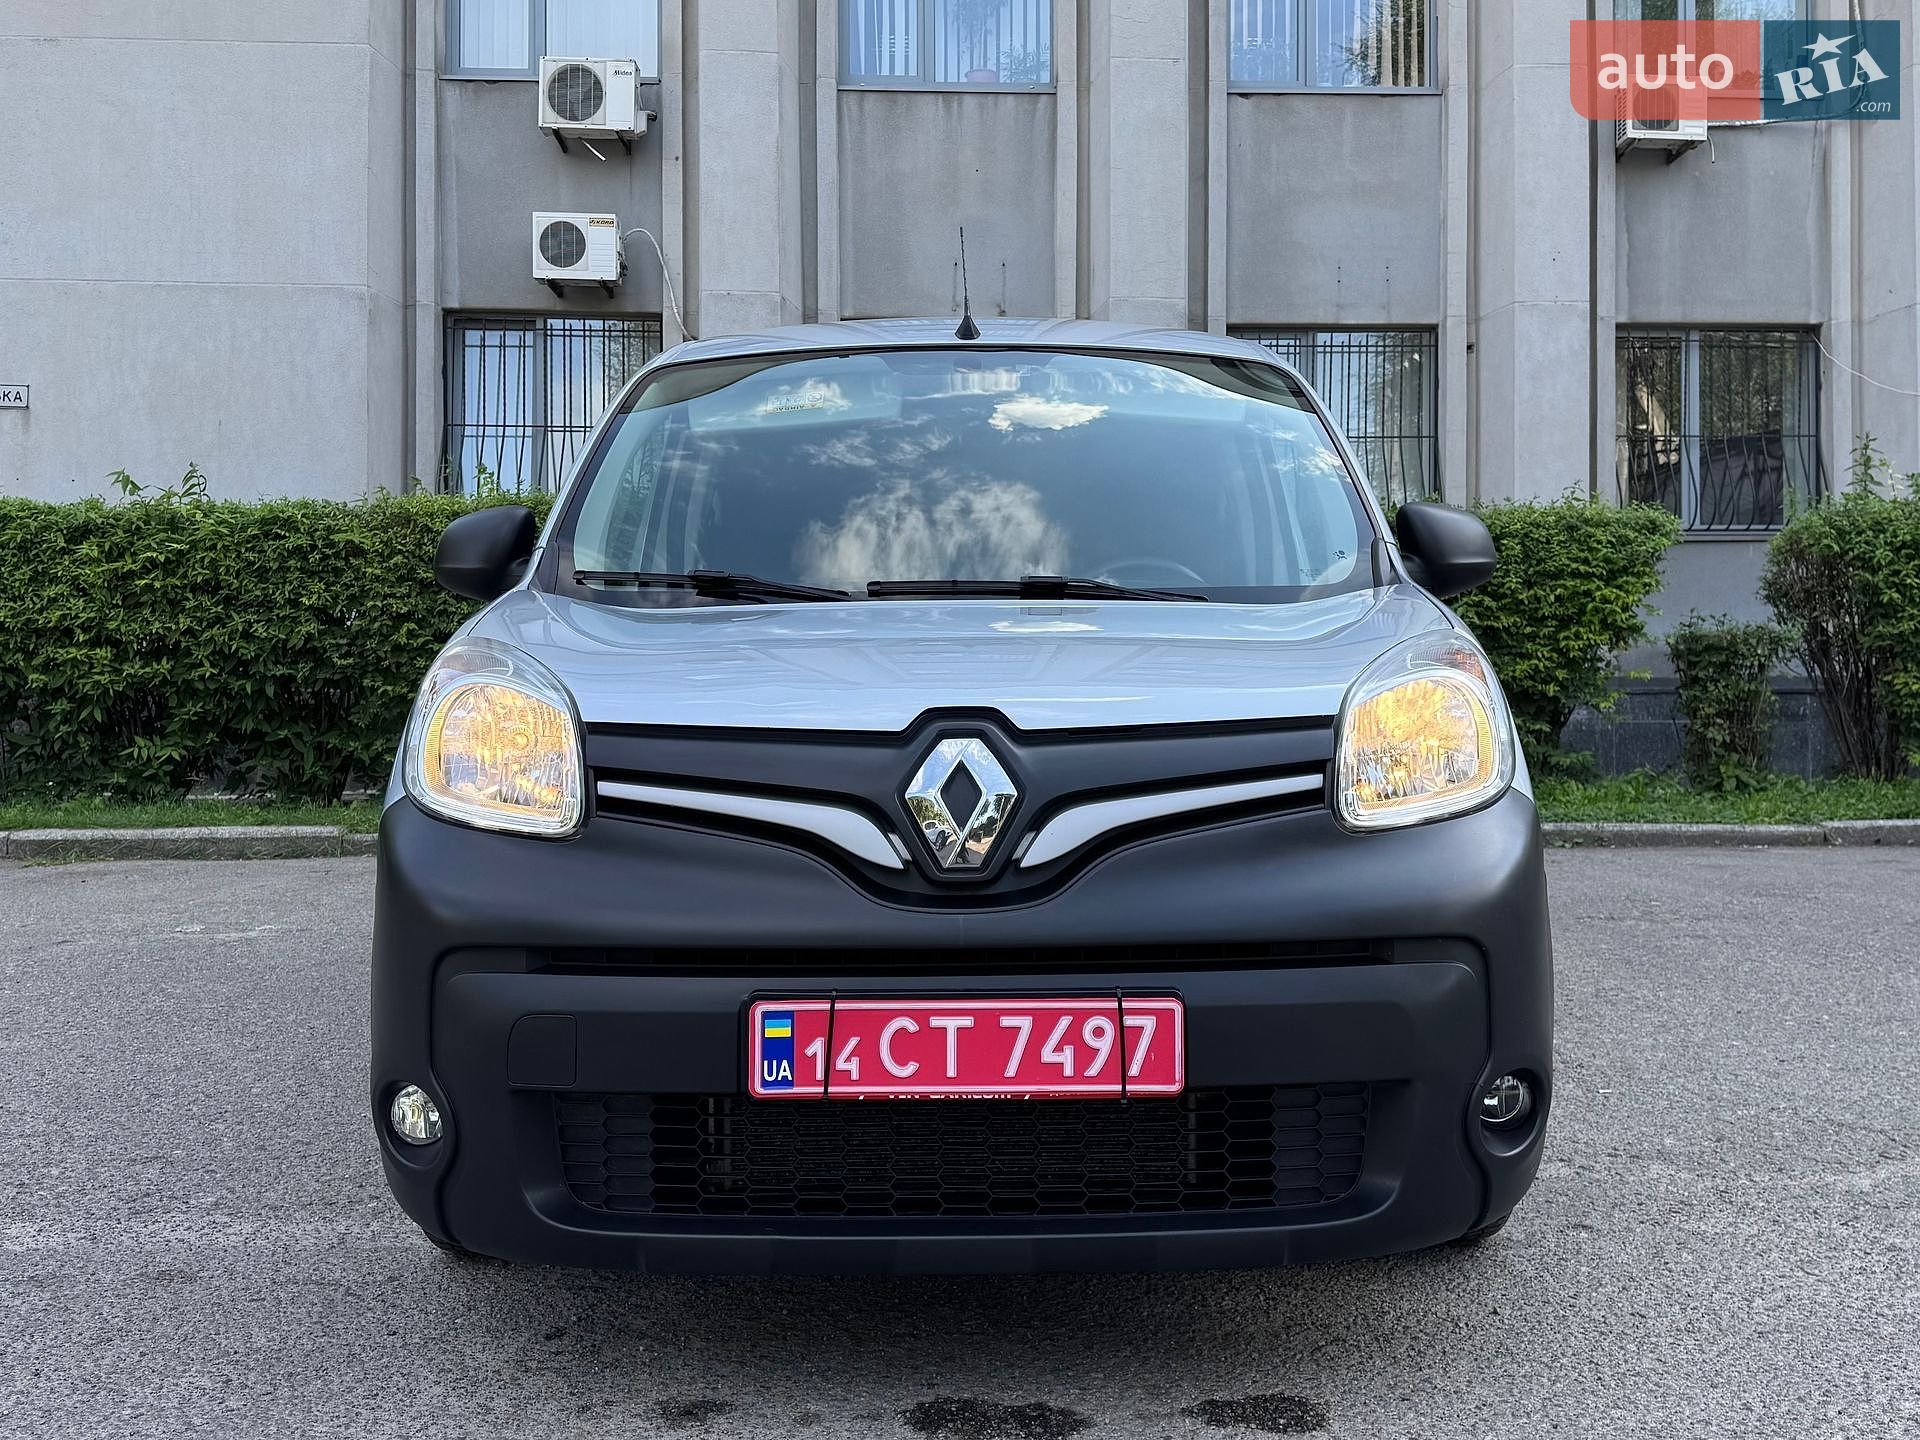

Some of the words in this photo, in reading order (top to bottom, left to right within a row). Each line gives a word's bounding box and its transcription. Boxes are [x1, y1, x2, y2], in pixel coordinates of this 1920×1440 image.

[0, 391, 22, 402] КА
[804, 1037, 861, 1080] 14
[879, 1016, 974, 1078] CT
[1000, 1016, 1157, 1078] 7497
[764, 1060, 792, 1081] UA
